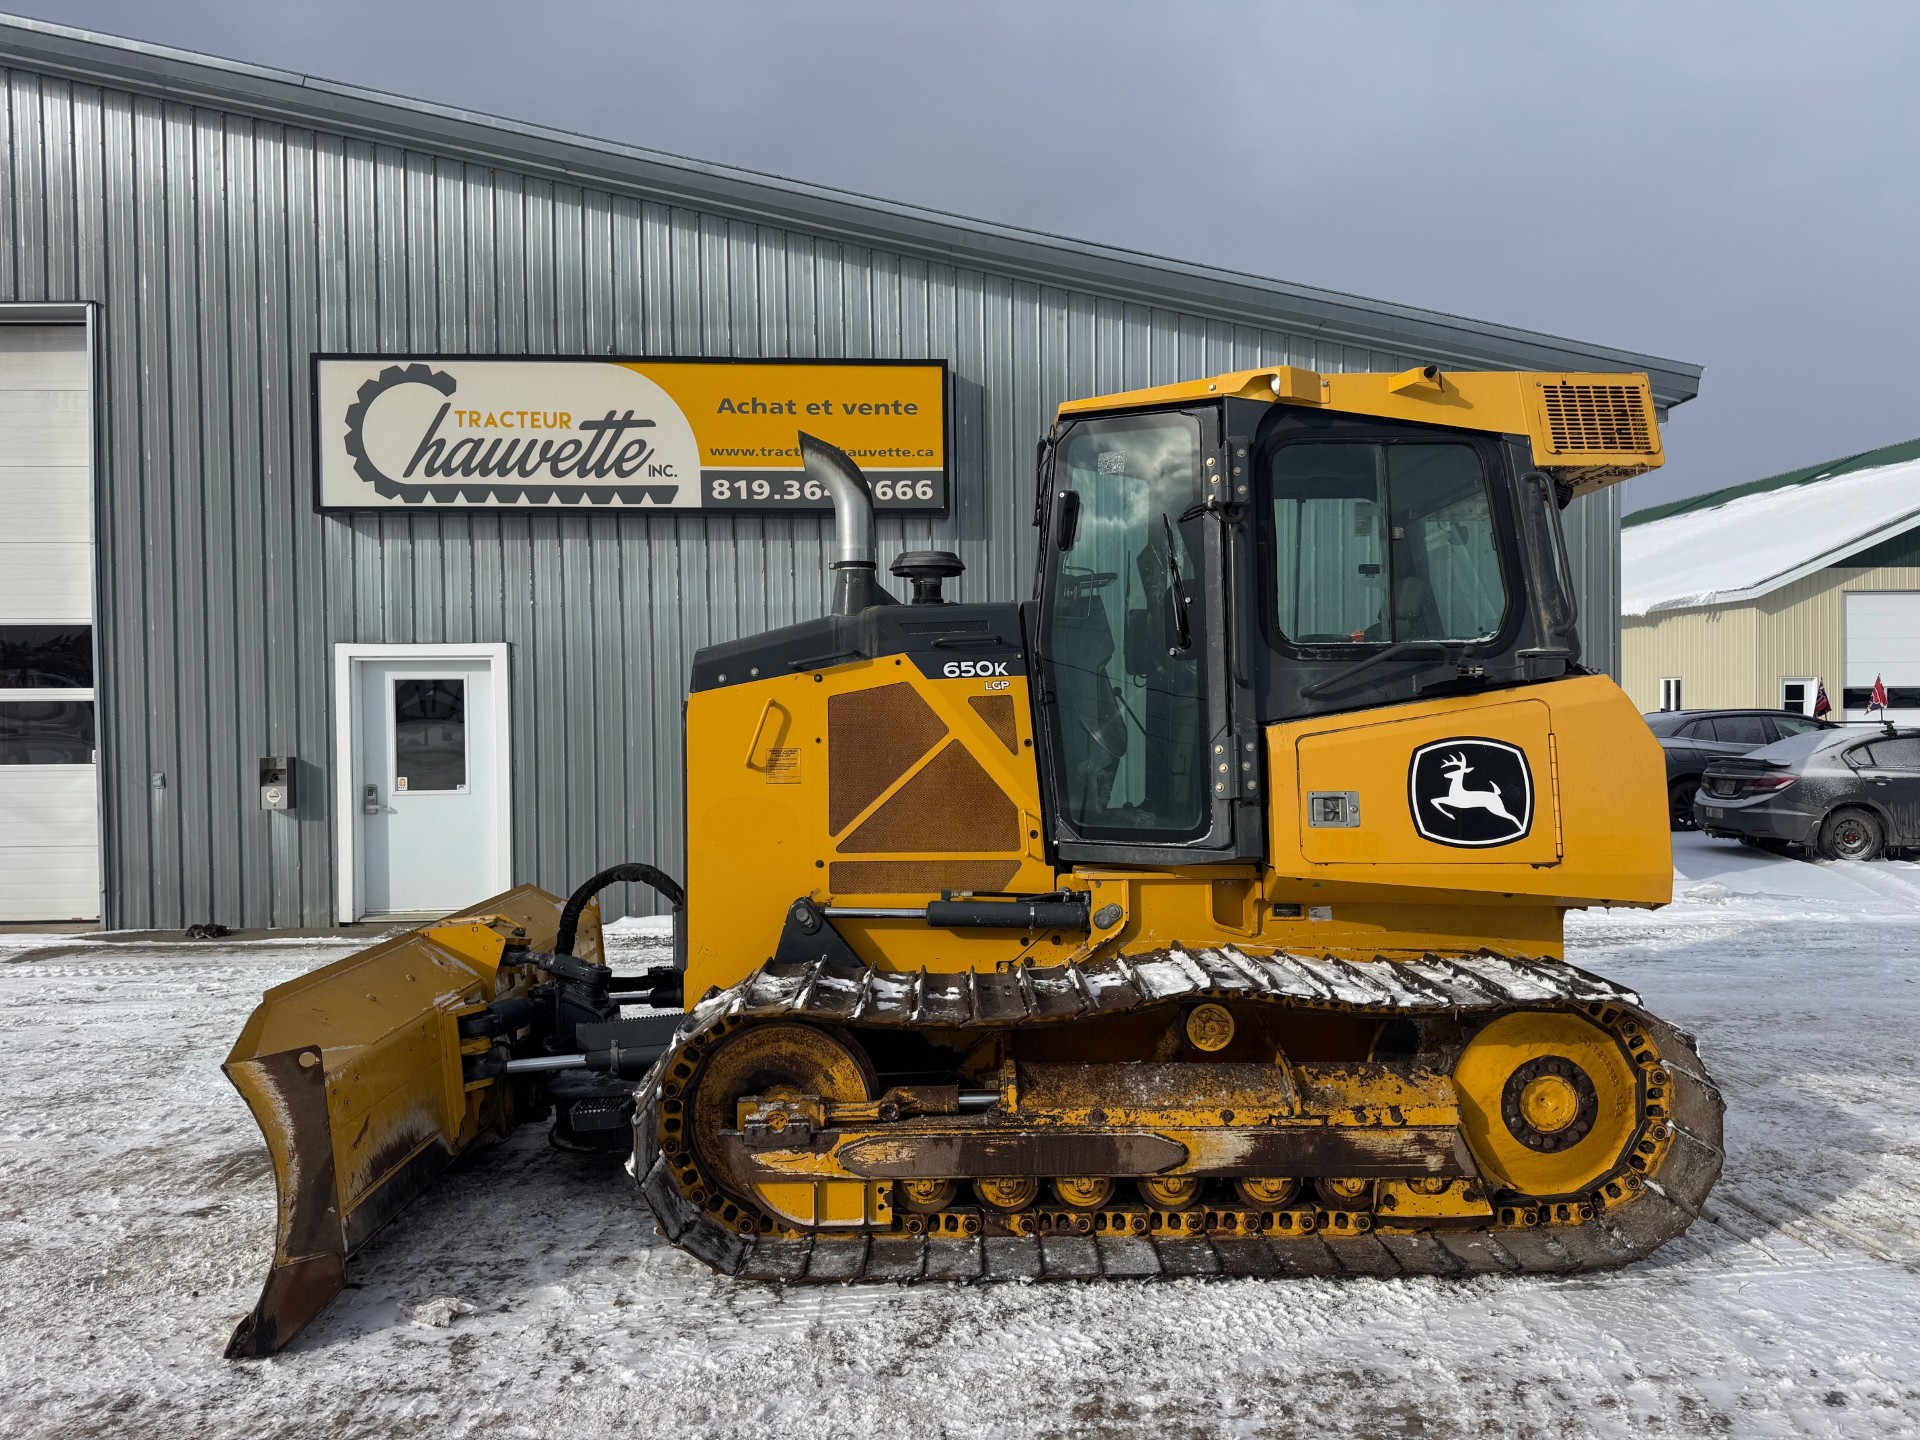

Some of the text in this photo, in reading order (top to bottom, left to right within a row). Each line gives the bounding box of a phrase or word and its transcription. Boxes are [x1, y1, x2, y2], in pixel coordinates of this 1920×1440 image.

[717, 397, 918, 416] Achat et vente
[454, 410, 572, 430] TRACTEUR
[344, 363, 679, 502] Chauvette INC.
[709, 446, 934, 457] www.tractauvette.ca
[711, 479, 934, 500] 819.36666
[943, 660, 1009, 678] 650K
[985, 680, 1011, 691] LGP
